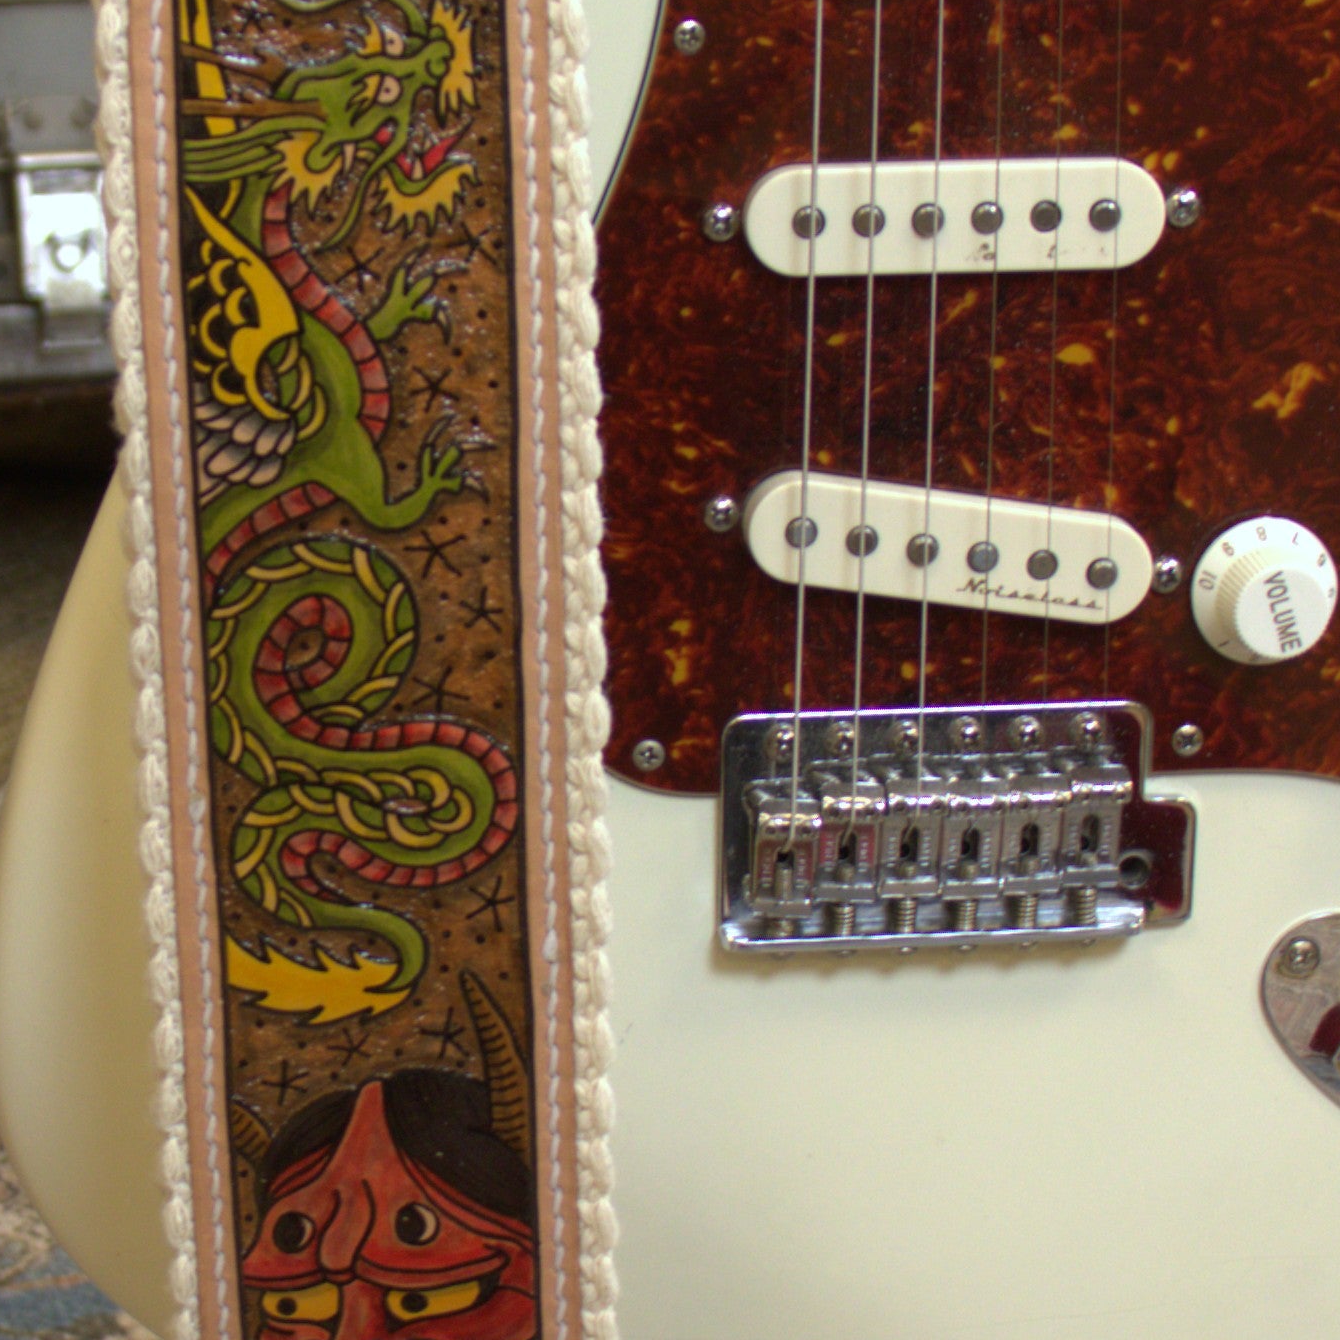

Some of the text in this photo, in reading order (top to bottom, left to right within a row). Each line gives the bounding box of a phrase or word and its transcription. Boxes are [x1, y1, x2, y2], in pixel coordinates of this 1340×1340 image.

[956, 577, 1103, 610] Noiseless
[1198, 569, 1217, 591] 10
[1262, 570, 1302, 653] VOLUME
